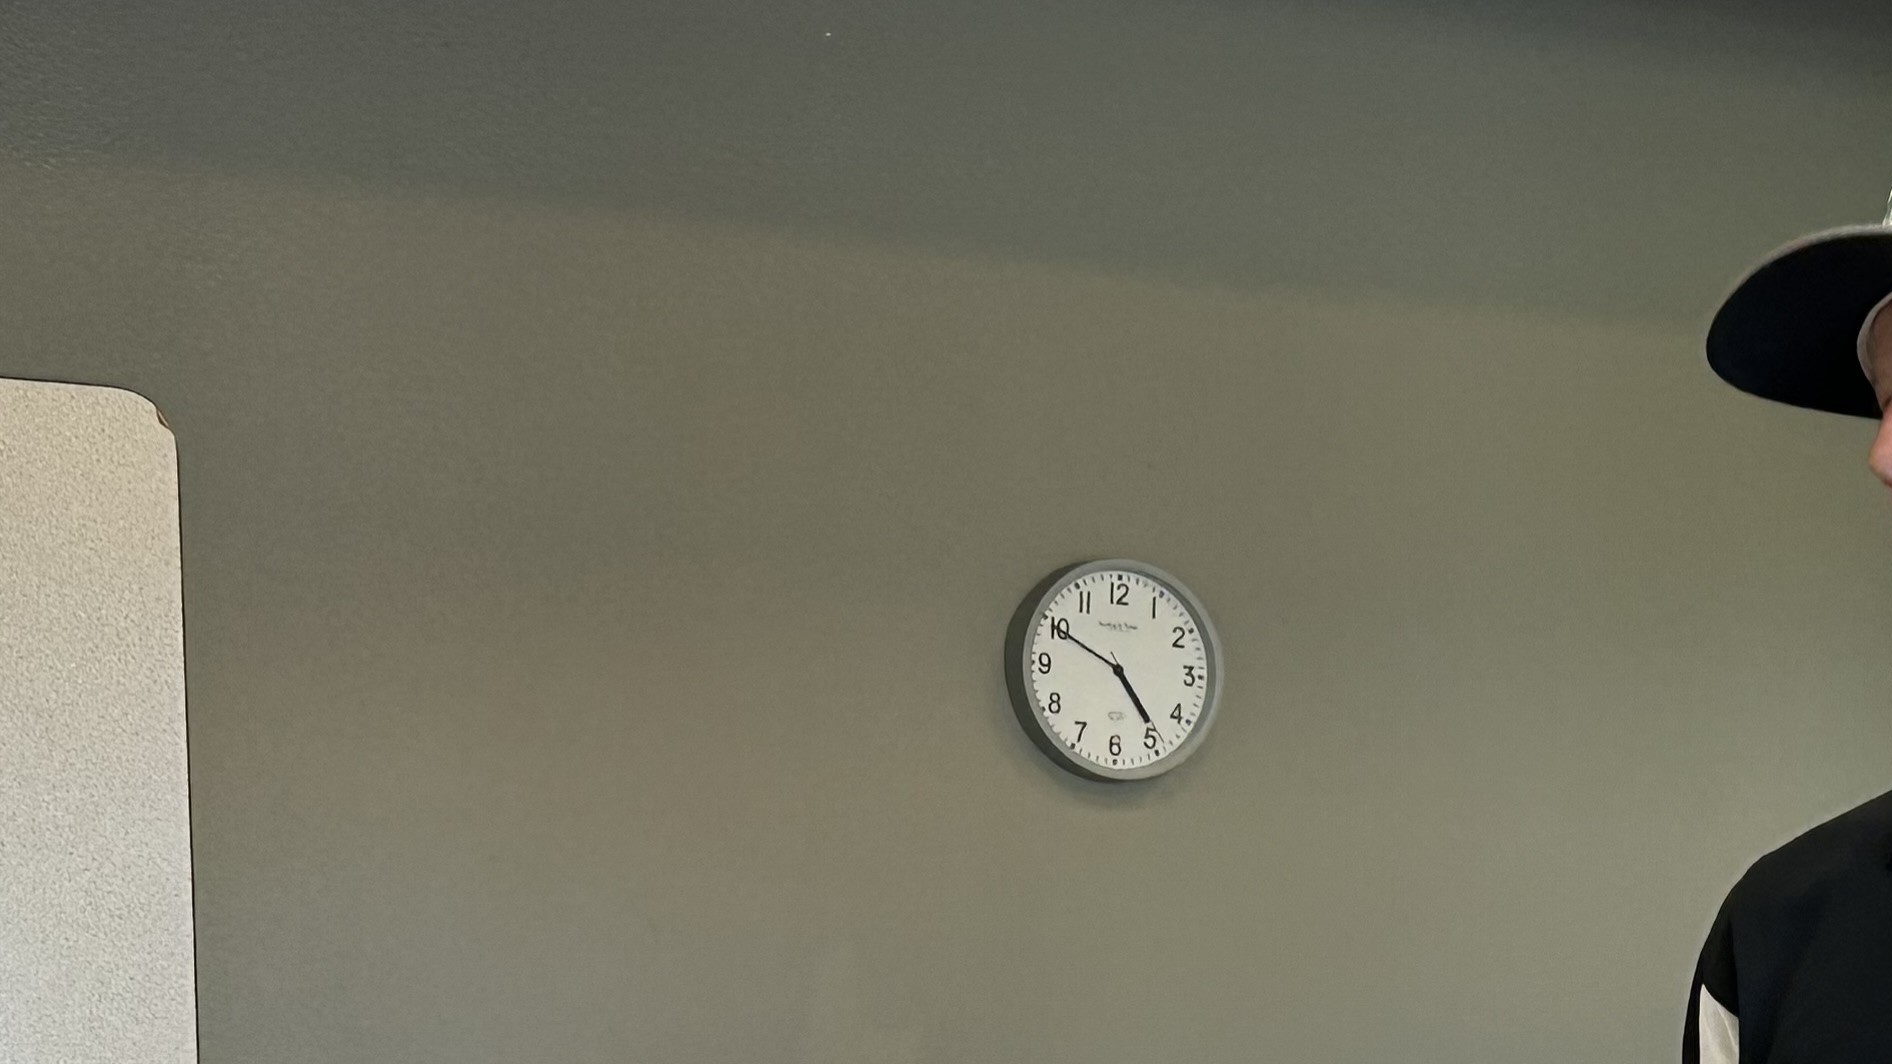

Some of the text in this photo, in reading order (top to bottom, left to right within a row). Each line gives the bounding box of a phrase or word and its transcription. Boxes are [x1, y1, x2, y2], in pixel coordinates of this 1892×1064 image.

[1079, 590, 1091, 614] 11
[1110, 581, 1130, 606] 12
[1152, 596, 1157, 619] 1
[1050, 616, 1070, 640] 10
[1172, 626, 1186, 649] 2
[1038, 652, 1052, 674] 9
[1183, 665, 1196, 687] 3
[1048, 692, 1061, 714] 8
[1170, 703, 1183, 724] 4
[1074, 721, 1088, 743] 7
[1143, 727, 1157, 750] 5
[1109, 735, 1122, 756] 6
